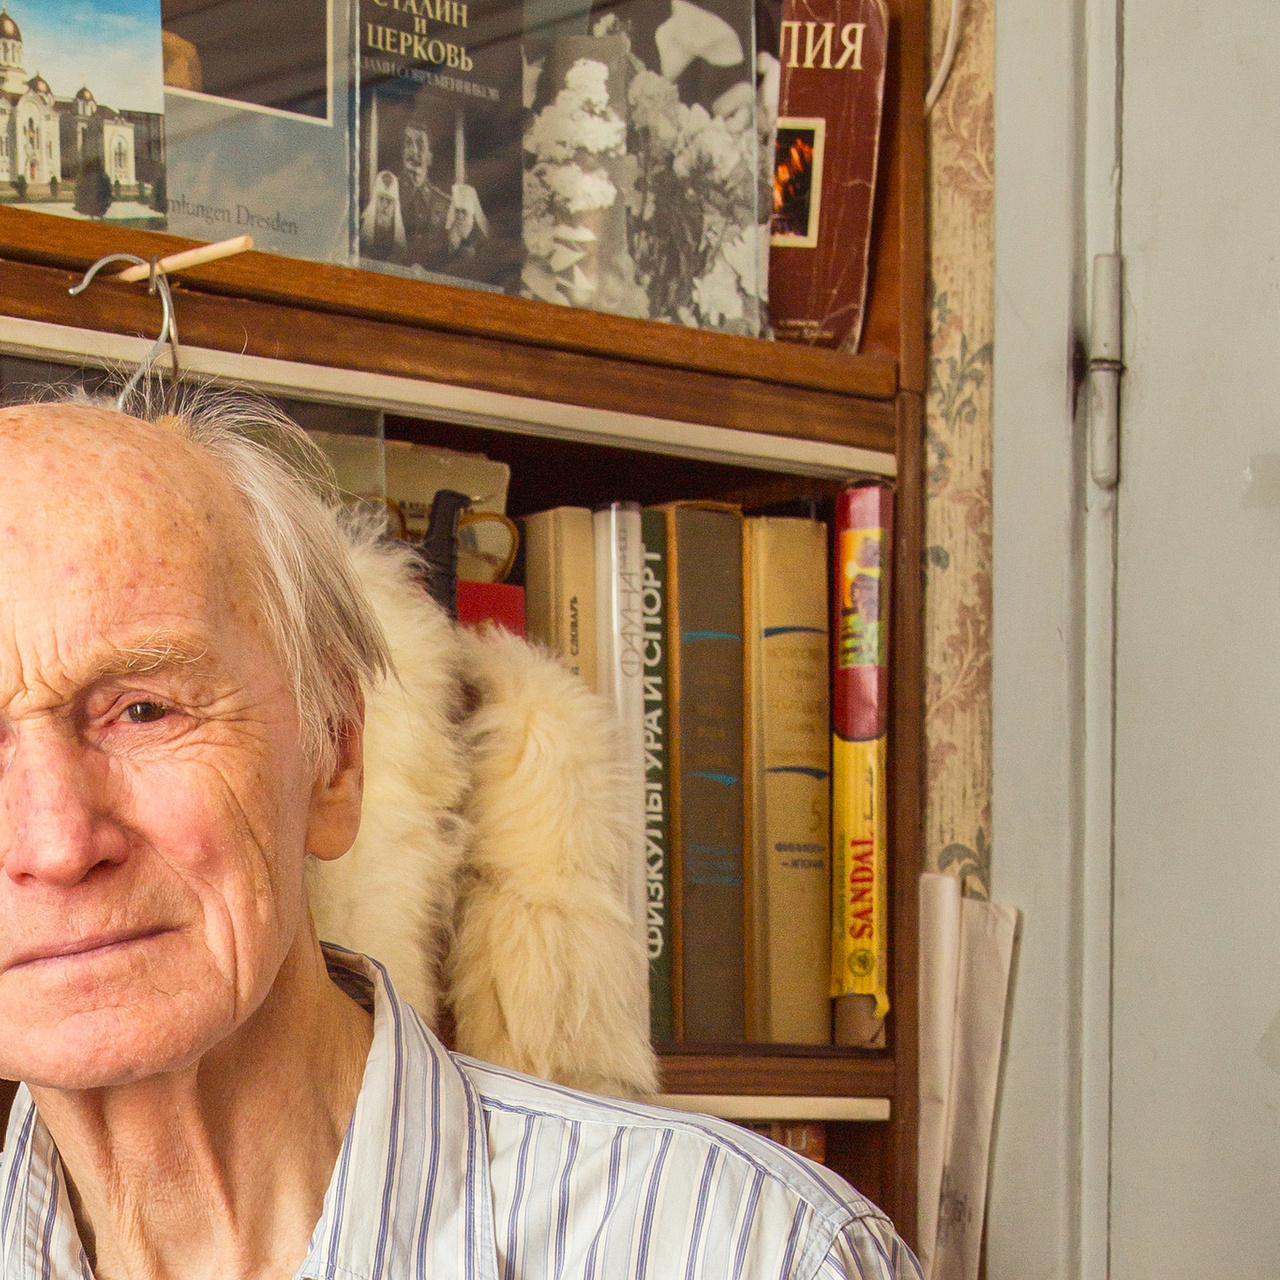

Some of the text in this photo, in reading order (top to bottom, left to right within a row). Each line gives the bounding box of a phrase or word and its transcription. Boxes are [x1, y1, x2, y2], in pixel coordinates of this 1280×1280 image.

[367, 22, 474, 72] ЦЕРКОВЬ
[413, 16, 428, 35] И
[235, 204, 299, 236] Dresden
[568, 595, 580, 657] СЛОВАРЬ
[643, 551, 665, 960] ФИЗКУЛЬТУРА И СПОРТ
[849, 832, 875, 940] SANDAL
